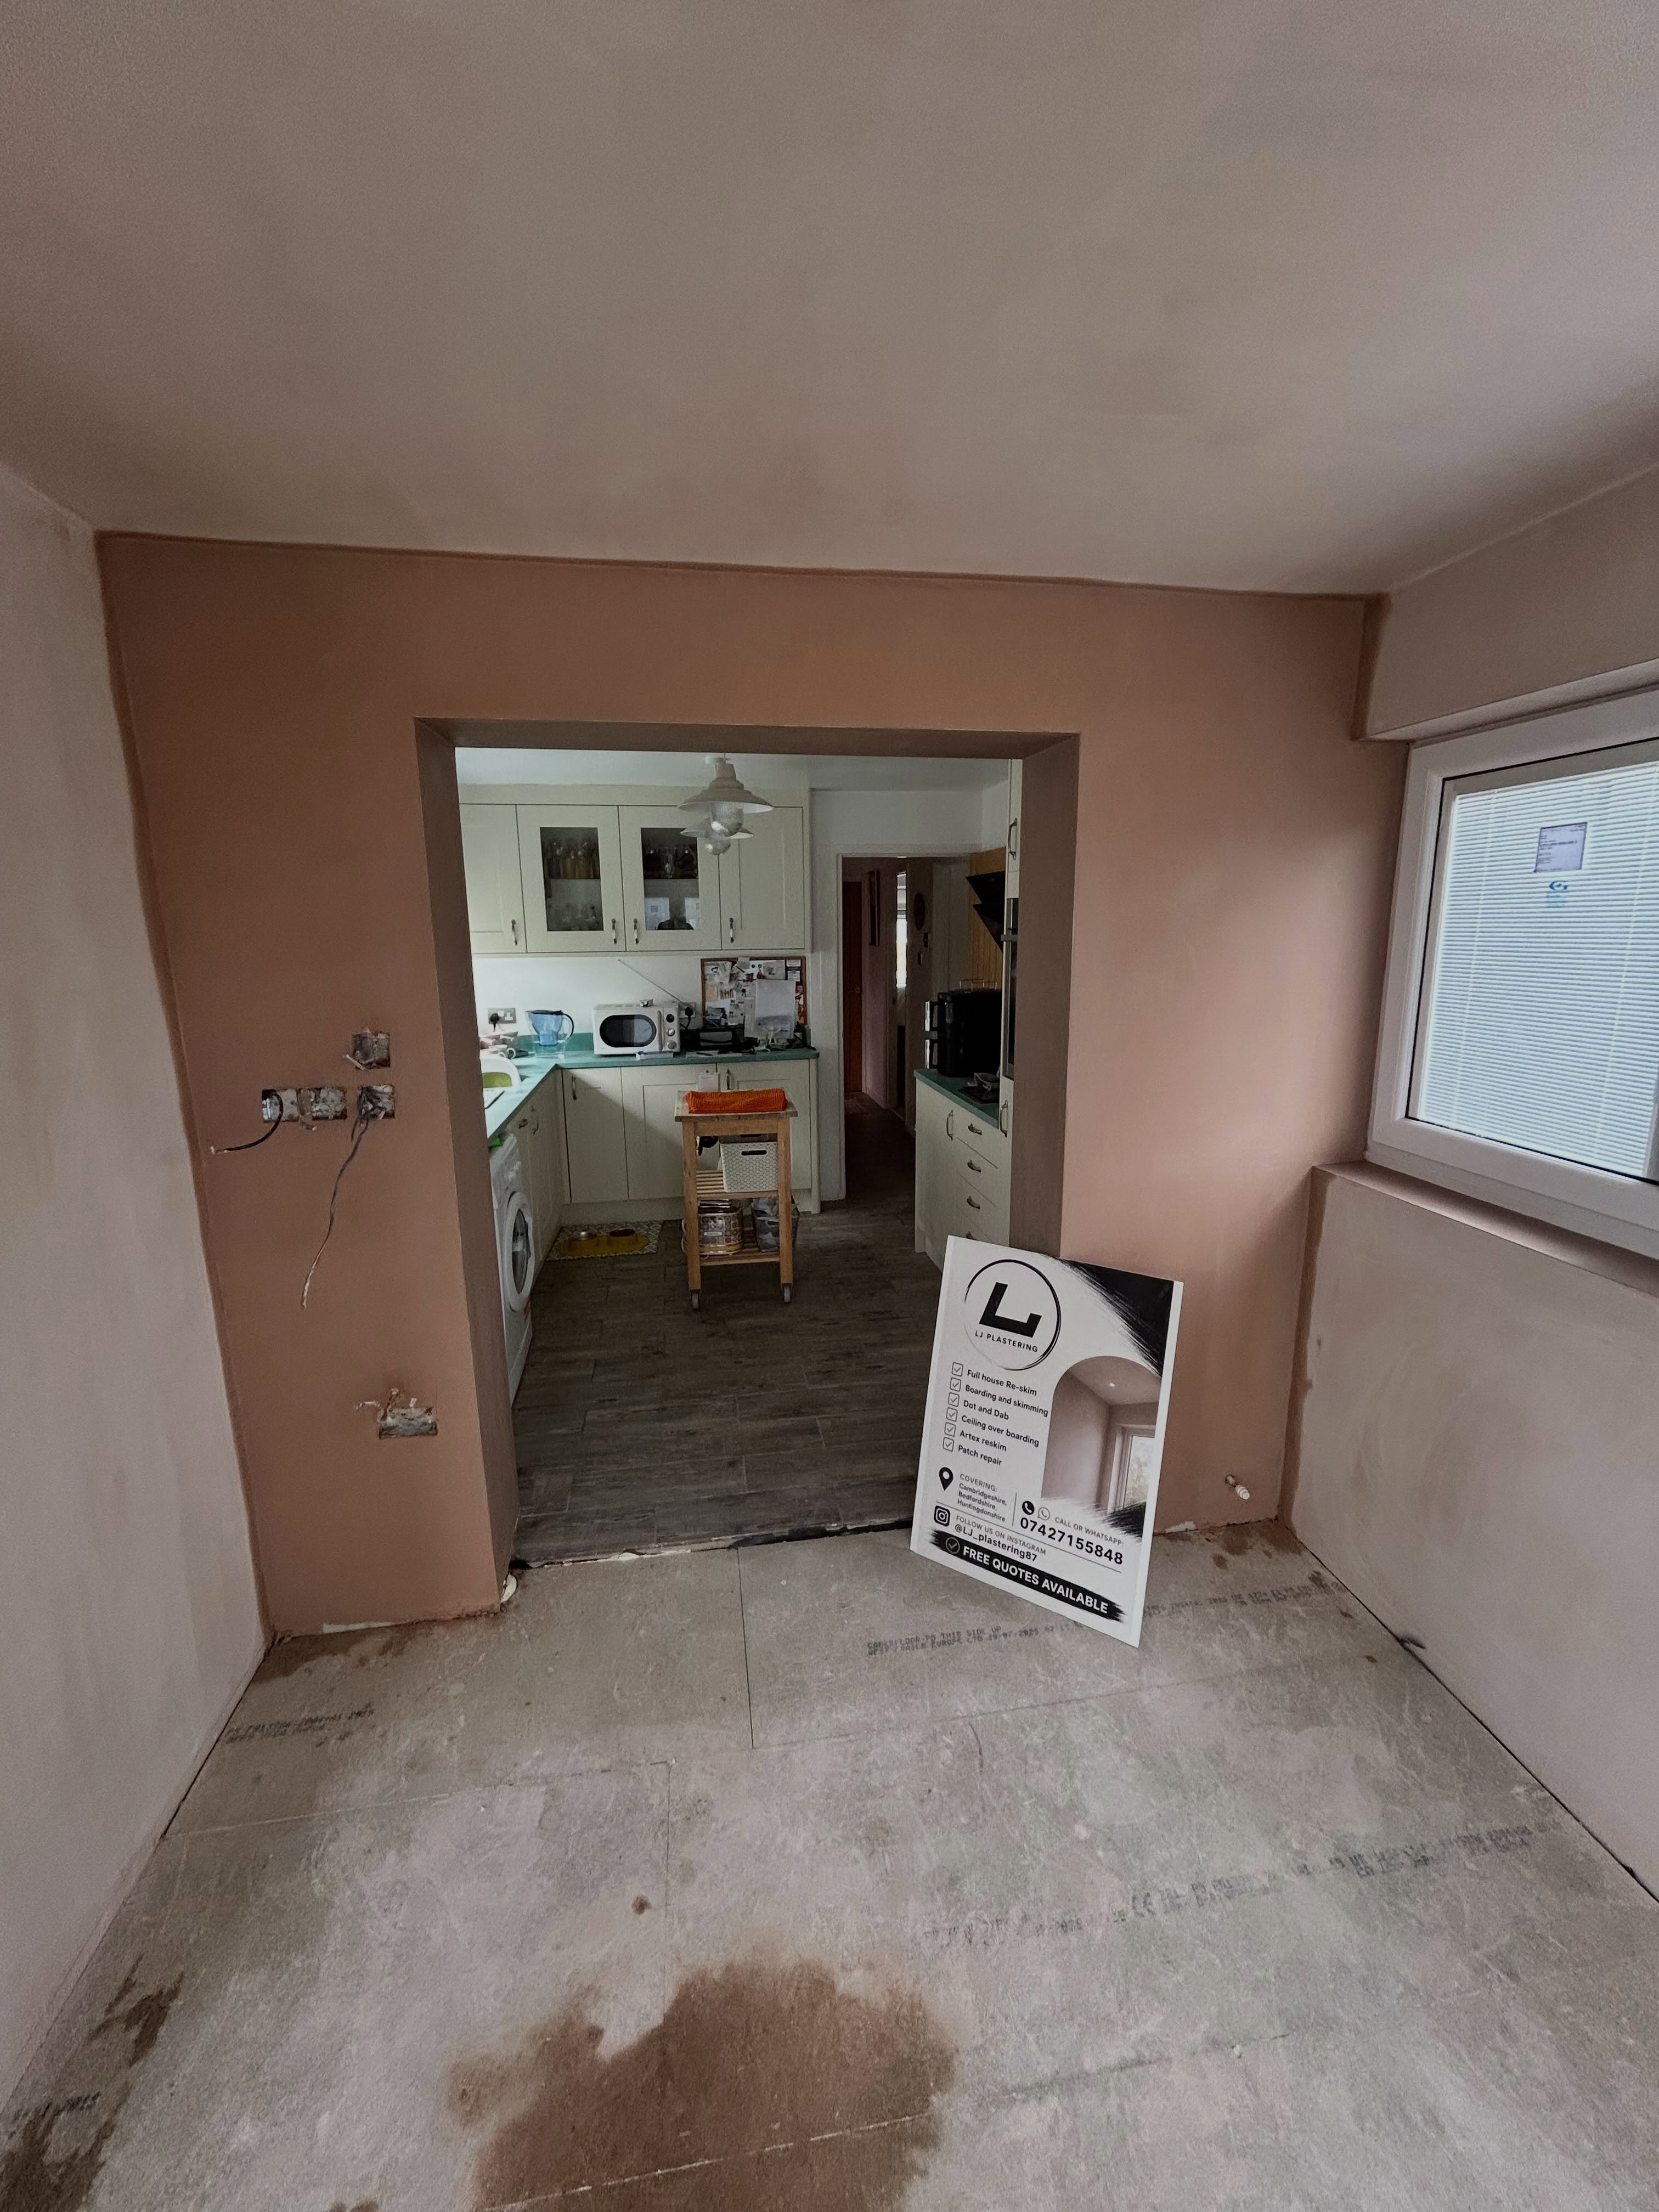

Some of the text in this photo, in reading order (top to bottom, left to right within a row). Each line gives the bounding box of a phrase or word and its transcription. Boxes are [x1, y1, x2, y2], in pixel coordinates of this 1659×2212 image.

[987, 1334, 1038, 1352] PLASTERING
[967, 1369, 1037, 1396] Full house Re-skim
[963, 1400, 1009, 1420] Dot and Dab
[966, 1385, 1048, 1417] Boarding and skimming
[960, 1430, 1007, 1452] Artex reskim
[962, 1415, 1040, 1447] Ceiling over boarding
[958, 1444, 1002, 1465] Patch repair
[959, 1483, 1007, 1506] Cambridgeshire,
[960, 1474, 997, 1492] COVERING:
[957, 1499, 1006, 1522] Huntingdonshire
[958, 1491, 997, 1511] Bedfordshire,
[955, 1524, 1037, 1561] @LJ_plastering87
[956, 1515, 983, 1530] FOLLOW
[1007, 1535, 1046, 1555] INSTAGRAM
[1020, 1517, 1123, 1565] 07427155848
[1055, 1517, 1071, 1528] CALL
[1085, 1527, 1124, 1547] WHATSAPP:
[963, 1545, 1108, 1614] FREE QUOTES AVAILABLE
